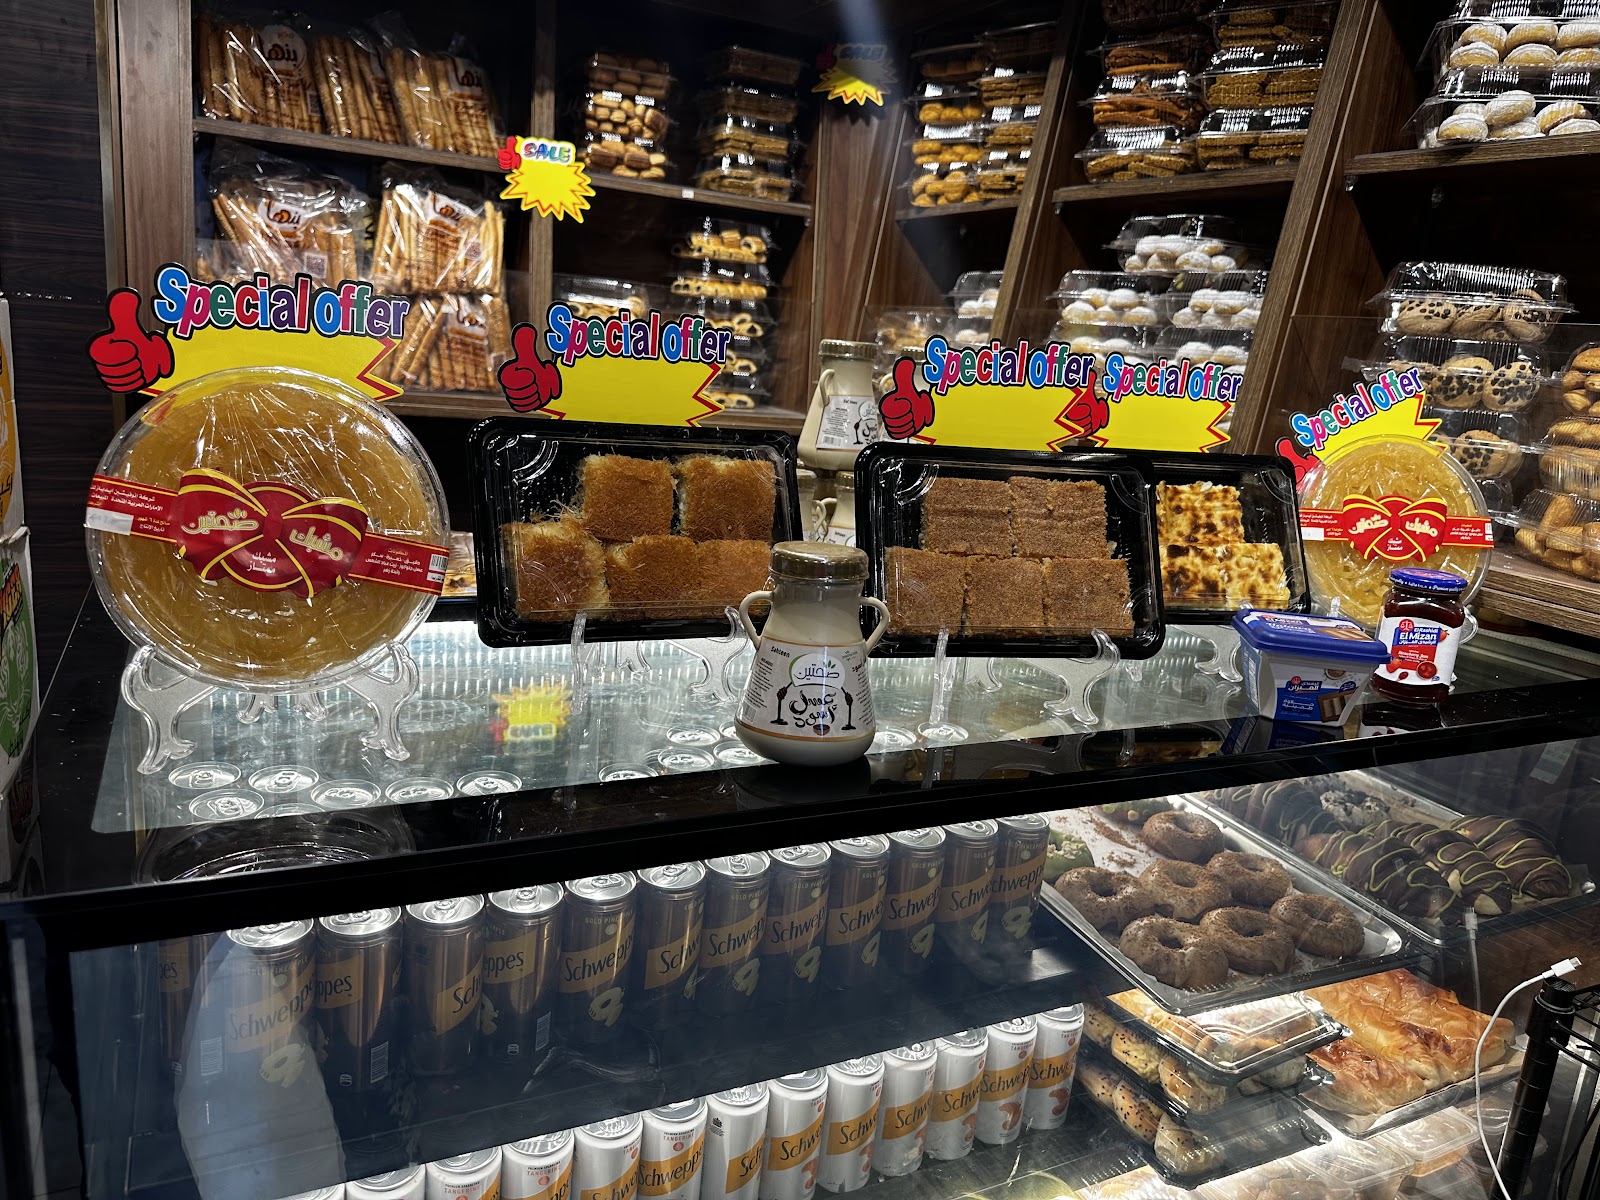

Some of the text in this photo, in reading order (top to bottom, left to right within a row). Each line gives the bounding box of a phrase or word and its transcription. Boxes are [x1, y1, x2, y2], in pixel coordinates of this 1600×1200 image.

[523, 142, 571, 163] SALE
[154, 266, 410, 338] Special offer
[547, 304, 660, 366] Special
[662, 316, 731, 362] offer
[924, 337, 1096, 394] Special offer
[1103, 353, 1243, 403] Special offer
[1292, 367, 1425, 449] Special offer
[289, 526, 344, 562] مشبك
[771, 646, 790, 658] Sahteen
[794, 662, 840, 681] صحتين
[789, 690, 837, 716] عسل
